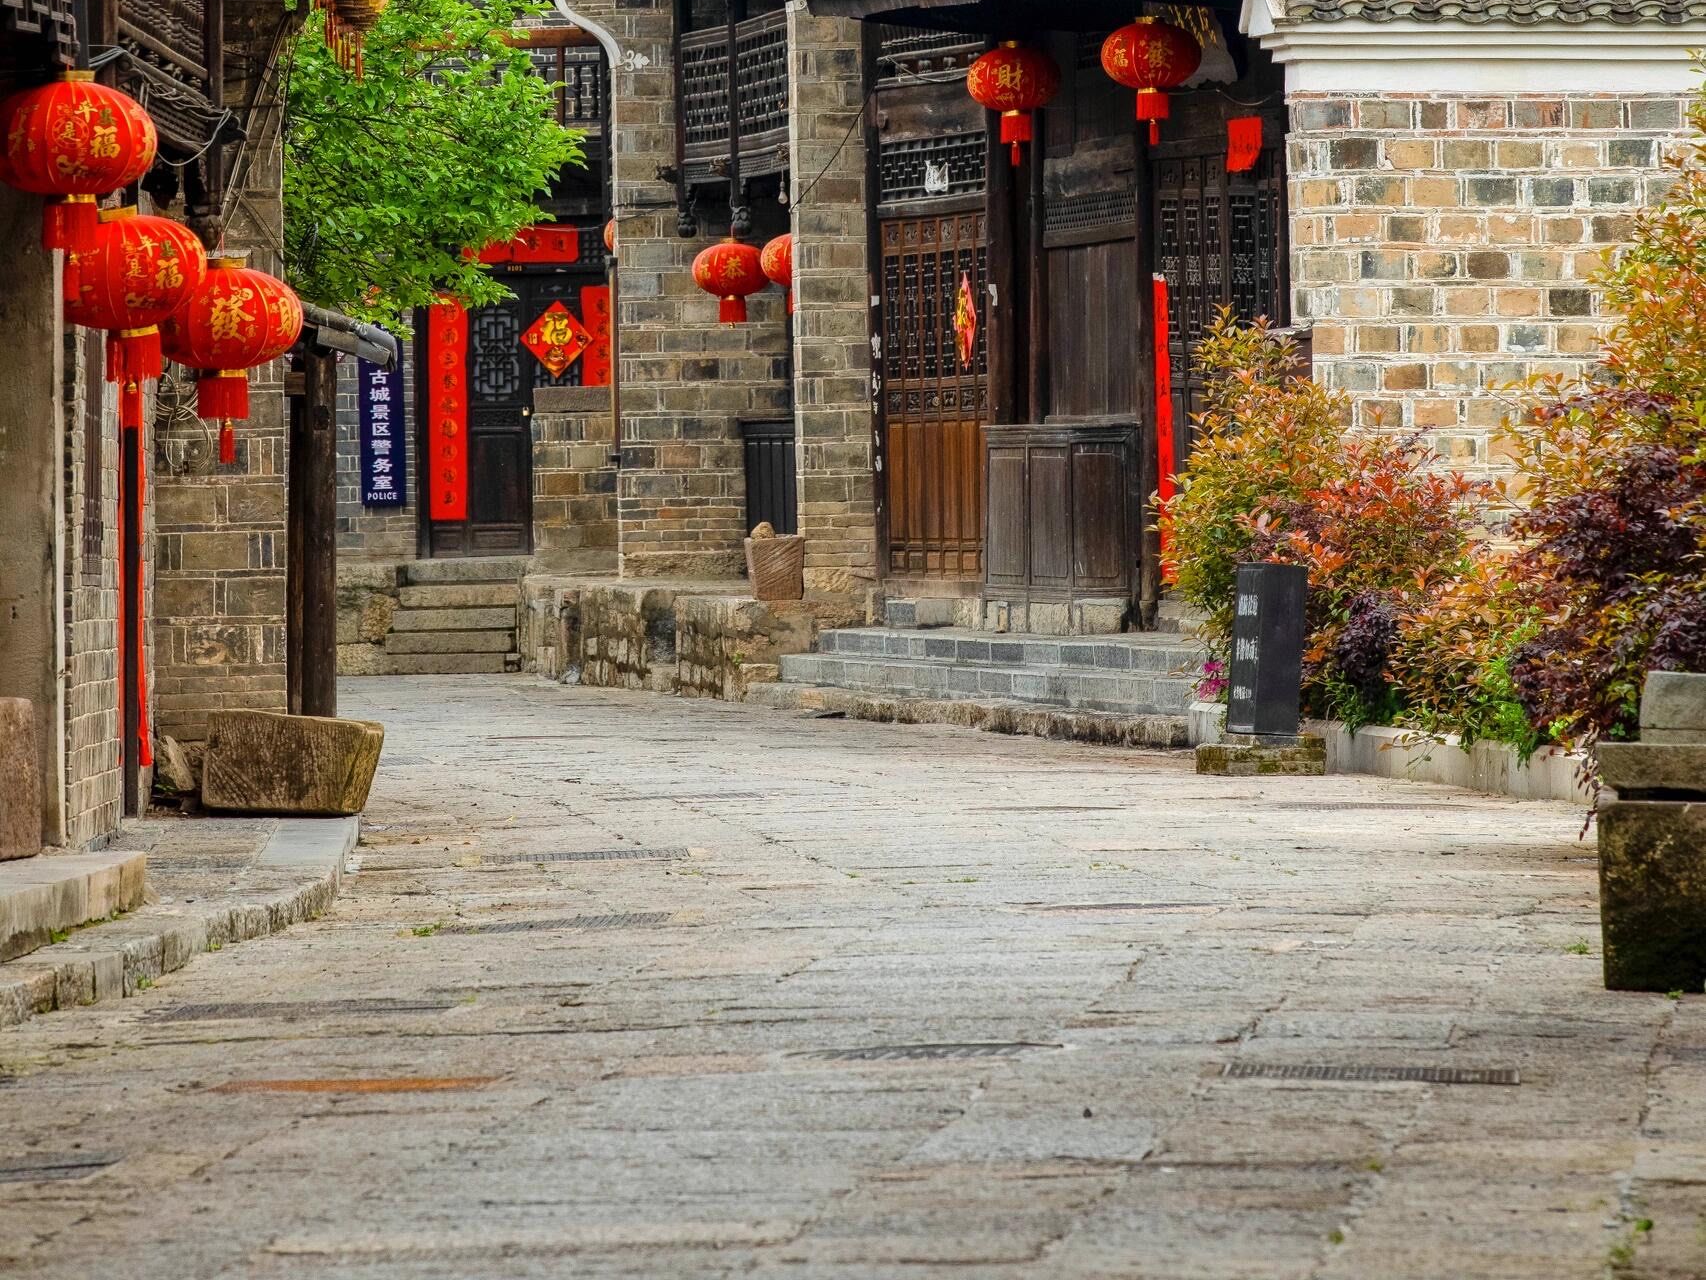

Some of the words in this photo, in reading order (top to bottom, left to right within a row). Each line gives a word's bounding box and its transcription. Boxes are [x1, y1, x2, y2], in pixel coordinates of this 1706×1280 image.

[995, 62, 1024, 91] 財
[90, 125, 122, 159] 福
[155, 257, 184, 290] 福
[540, 311, 573, 346] 福
[366, 361, 393, 490] 古城景区警务室
[367, 491, 398, 501] POLICE
